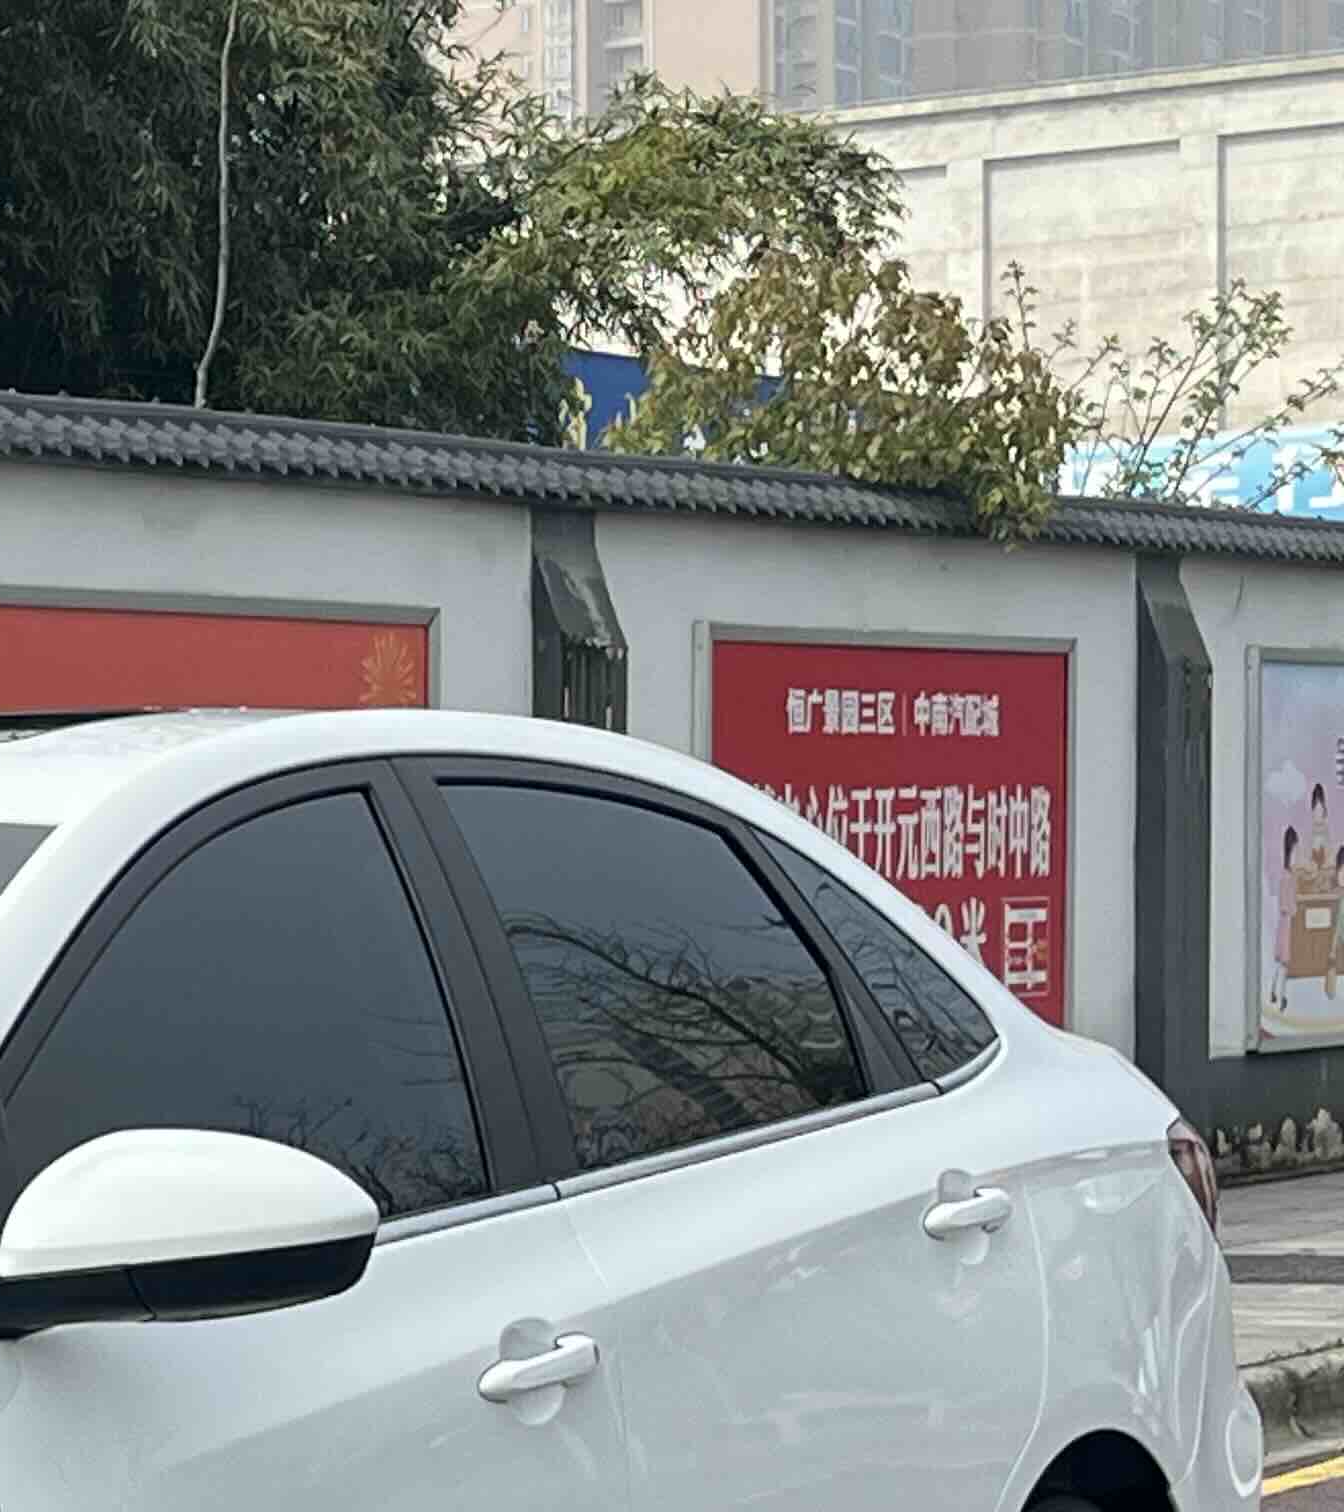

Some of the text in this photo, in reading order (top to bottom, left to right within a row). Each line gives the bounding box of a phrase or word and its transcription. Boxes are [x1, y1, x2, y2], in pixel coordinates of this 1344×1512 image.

[752, 783, 1051, 880] 位于开元西路与时中路
